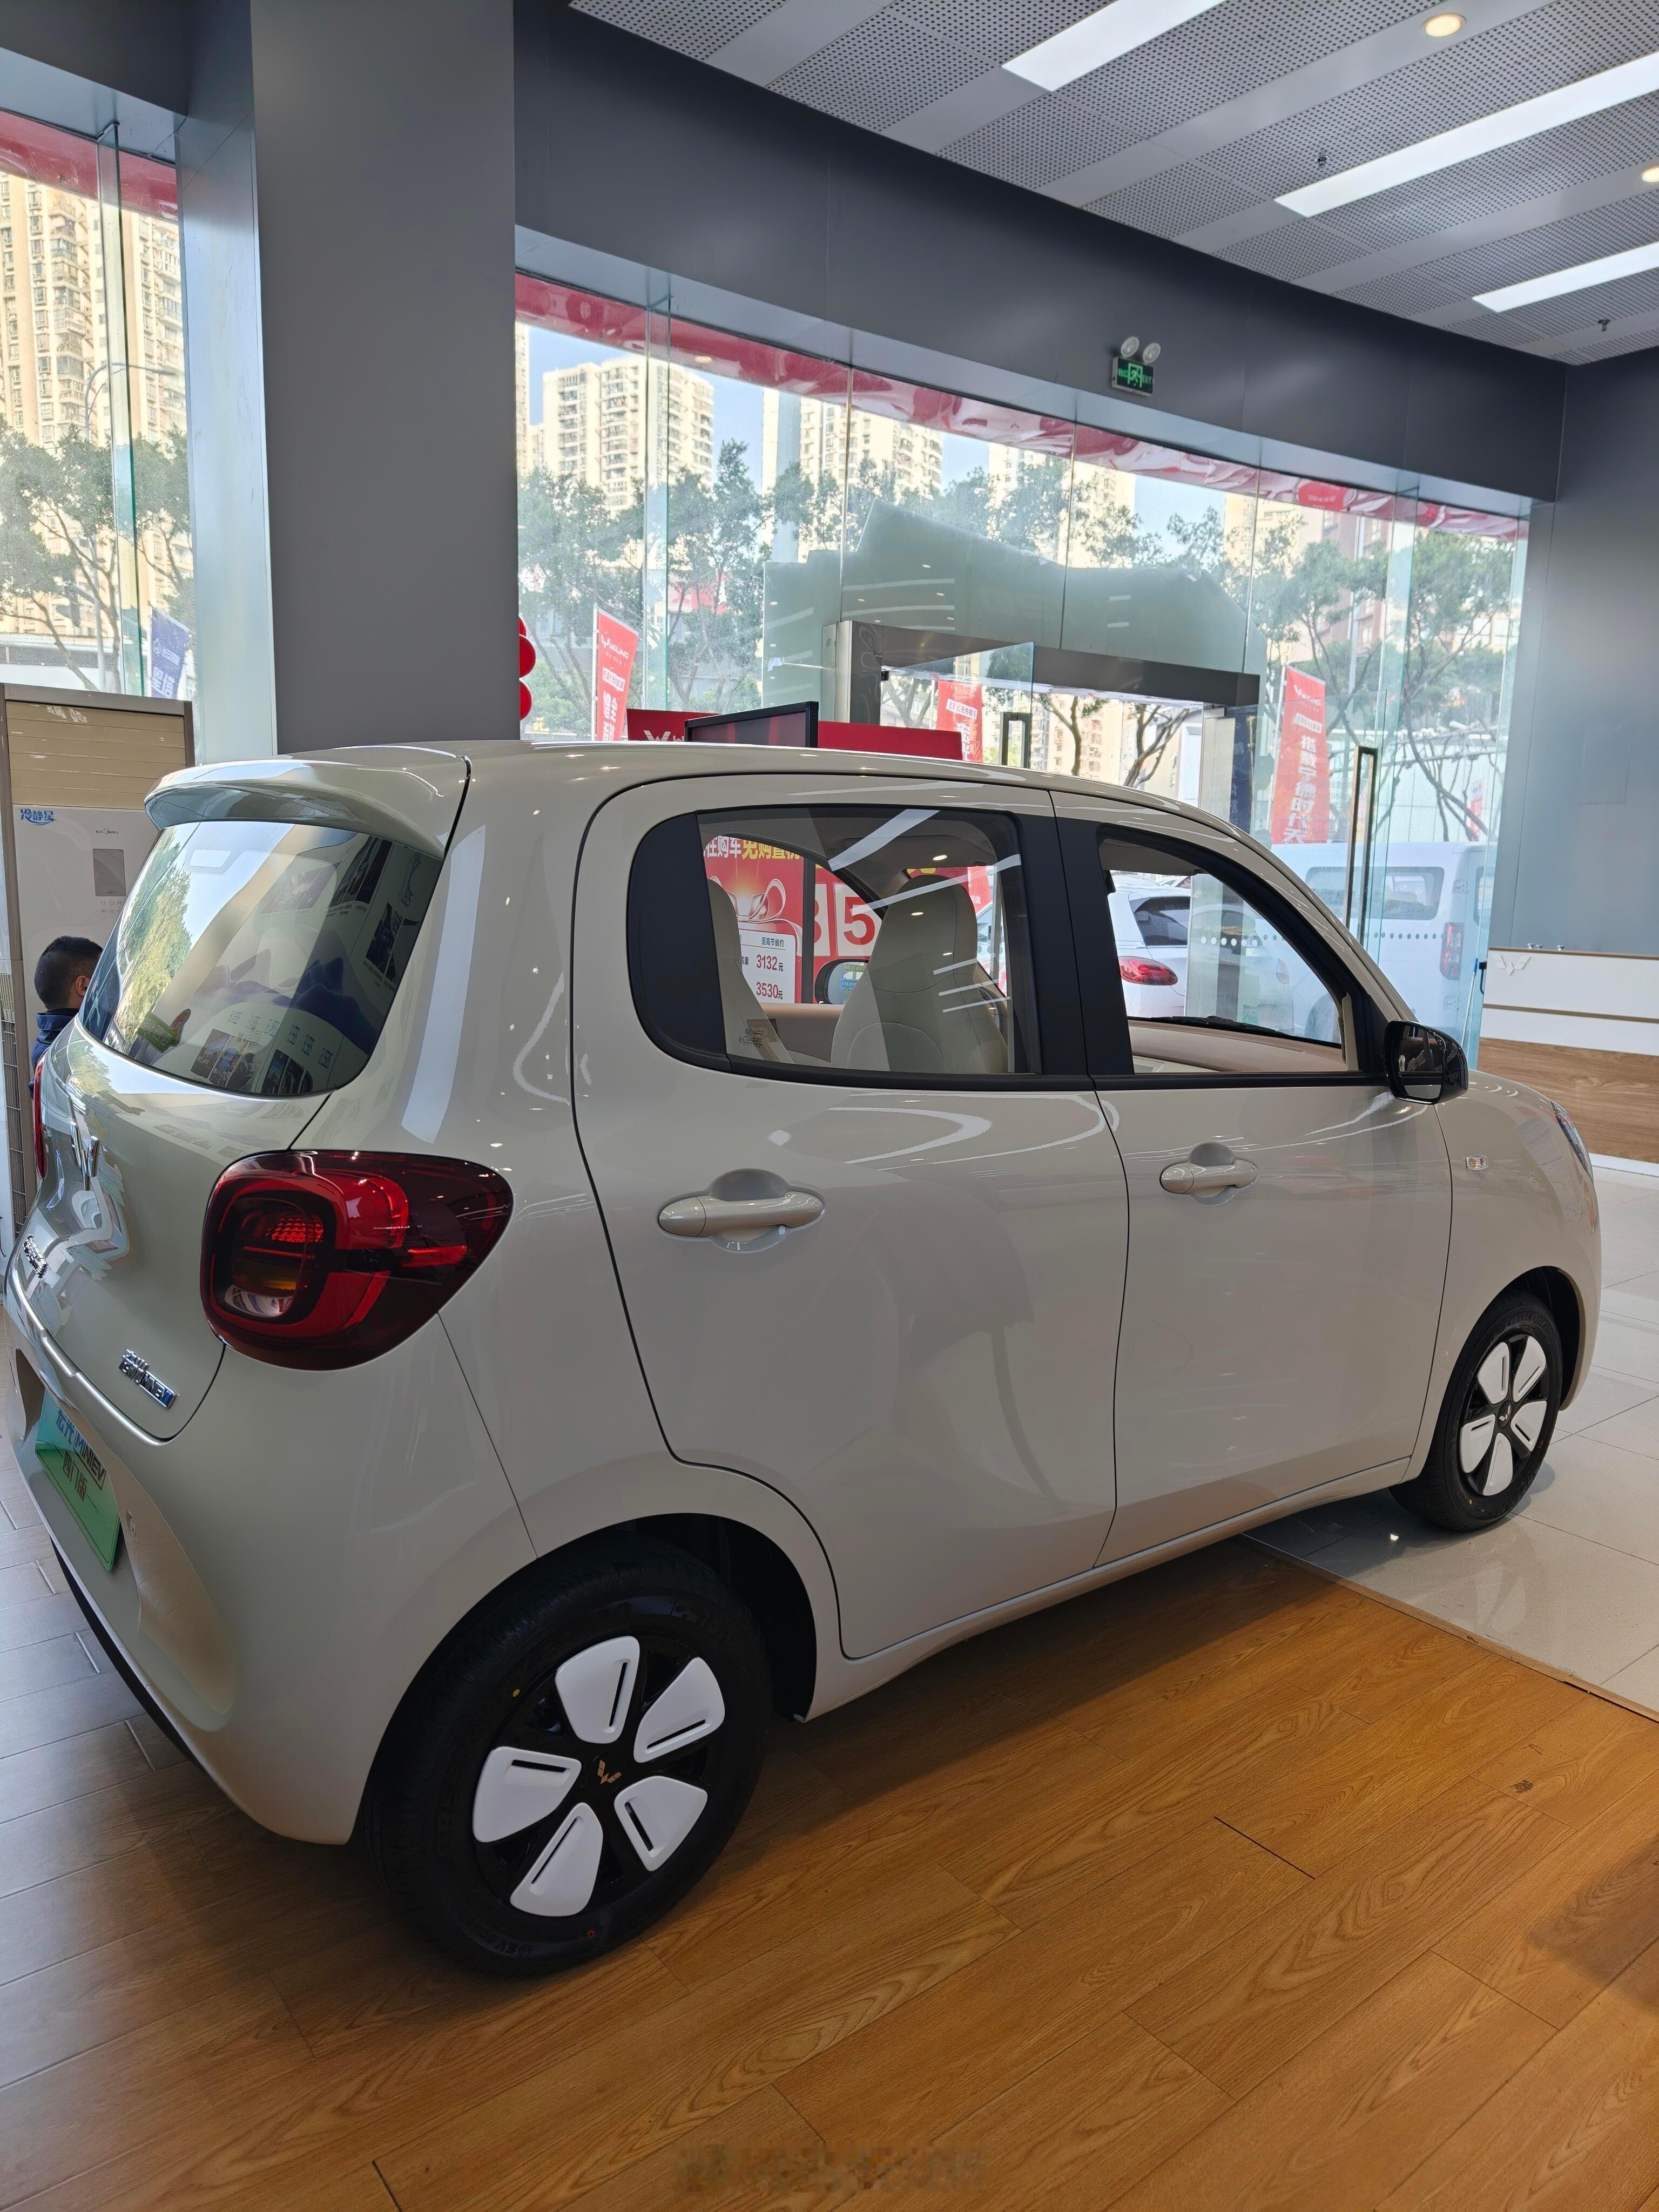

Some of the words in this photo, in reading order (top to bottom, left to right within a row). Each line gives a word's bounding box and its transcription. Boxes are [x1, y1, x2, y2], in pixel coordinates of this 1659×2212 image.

[20, 808, 55, 821] 冷静星
[761, 936, 785, 947] 至高节省约
[63, 1451, 88, 1502] 四门版
